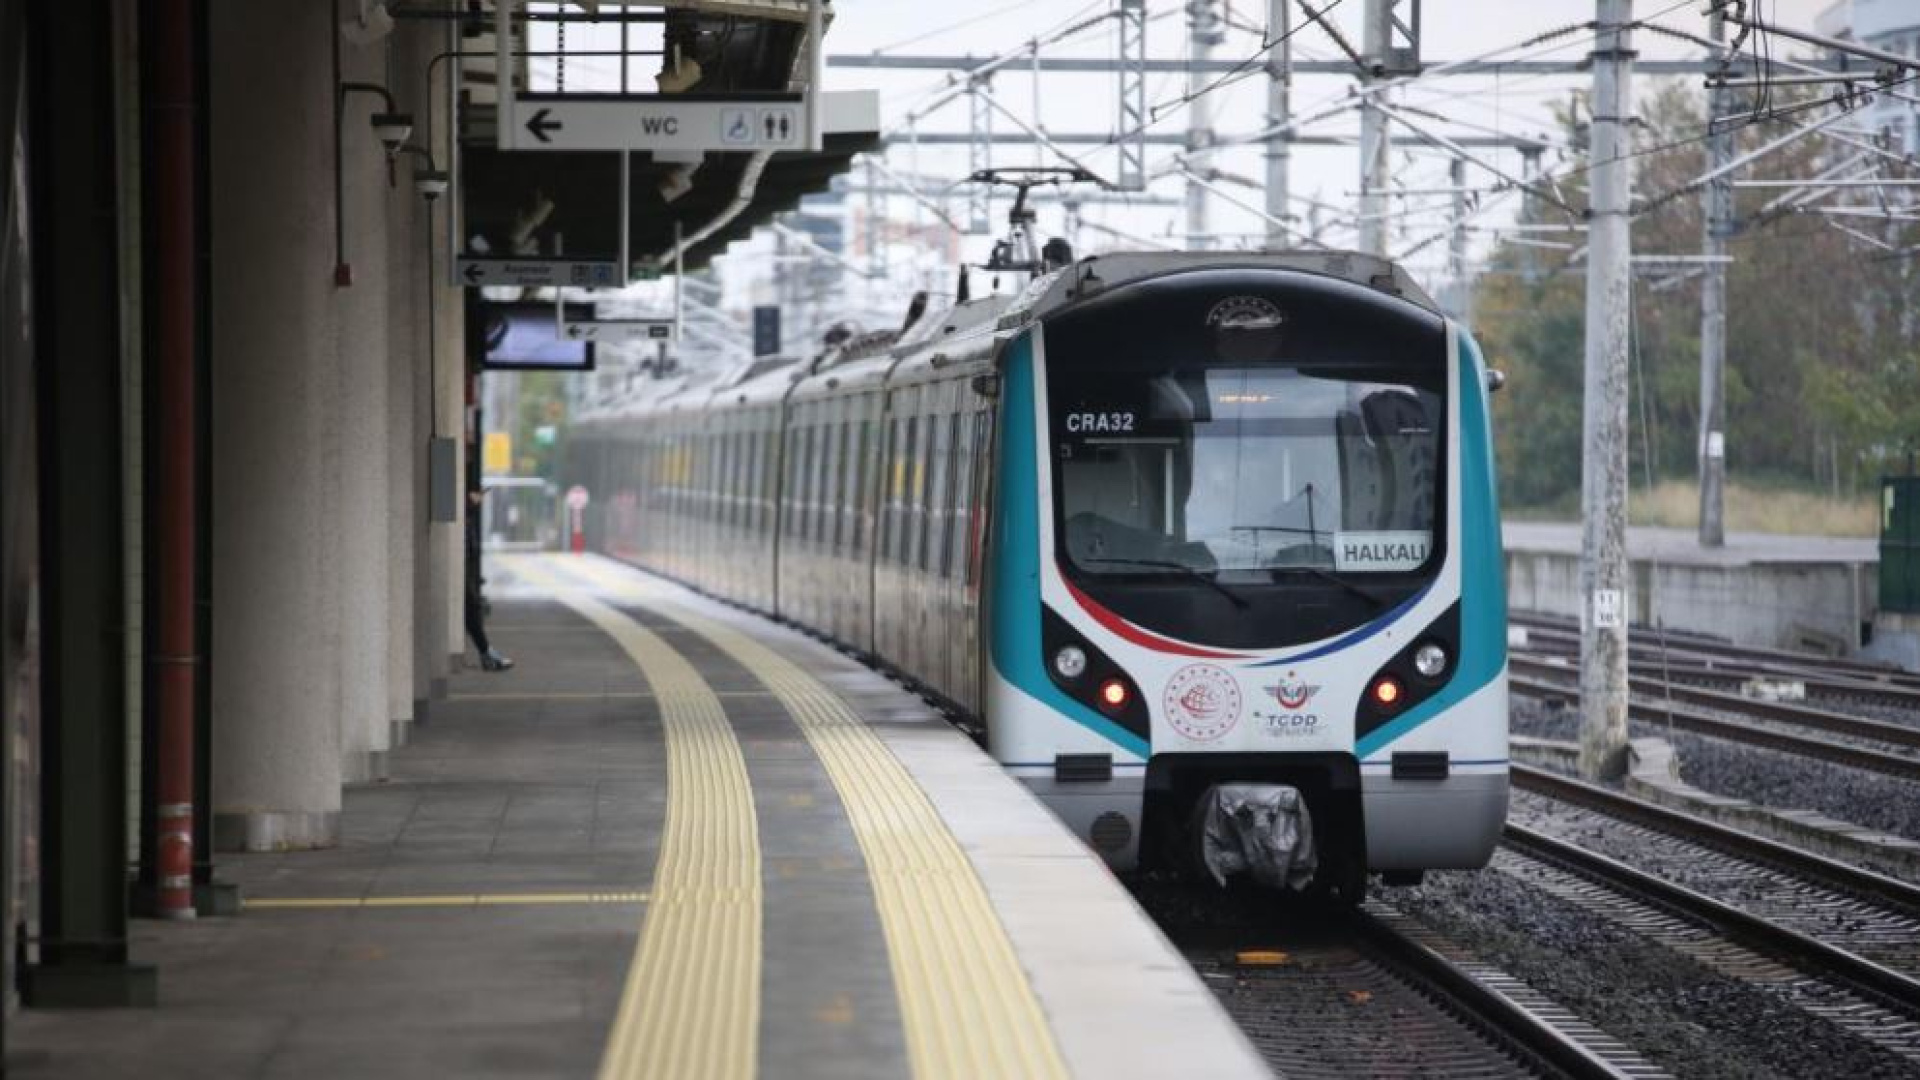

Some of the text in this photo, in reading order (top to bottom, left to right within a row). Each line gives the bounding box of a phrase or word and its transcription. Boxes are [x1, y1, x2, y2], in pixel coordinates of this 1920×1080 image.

[641, 116, 678, 136] WC
[1066, 412, 1133, 432] CRA32
[1343, 543, 1425, 561] HALKALI
[1267, 714, 1319, 727] TCDD
